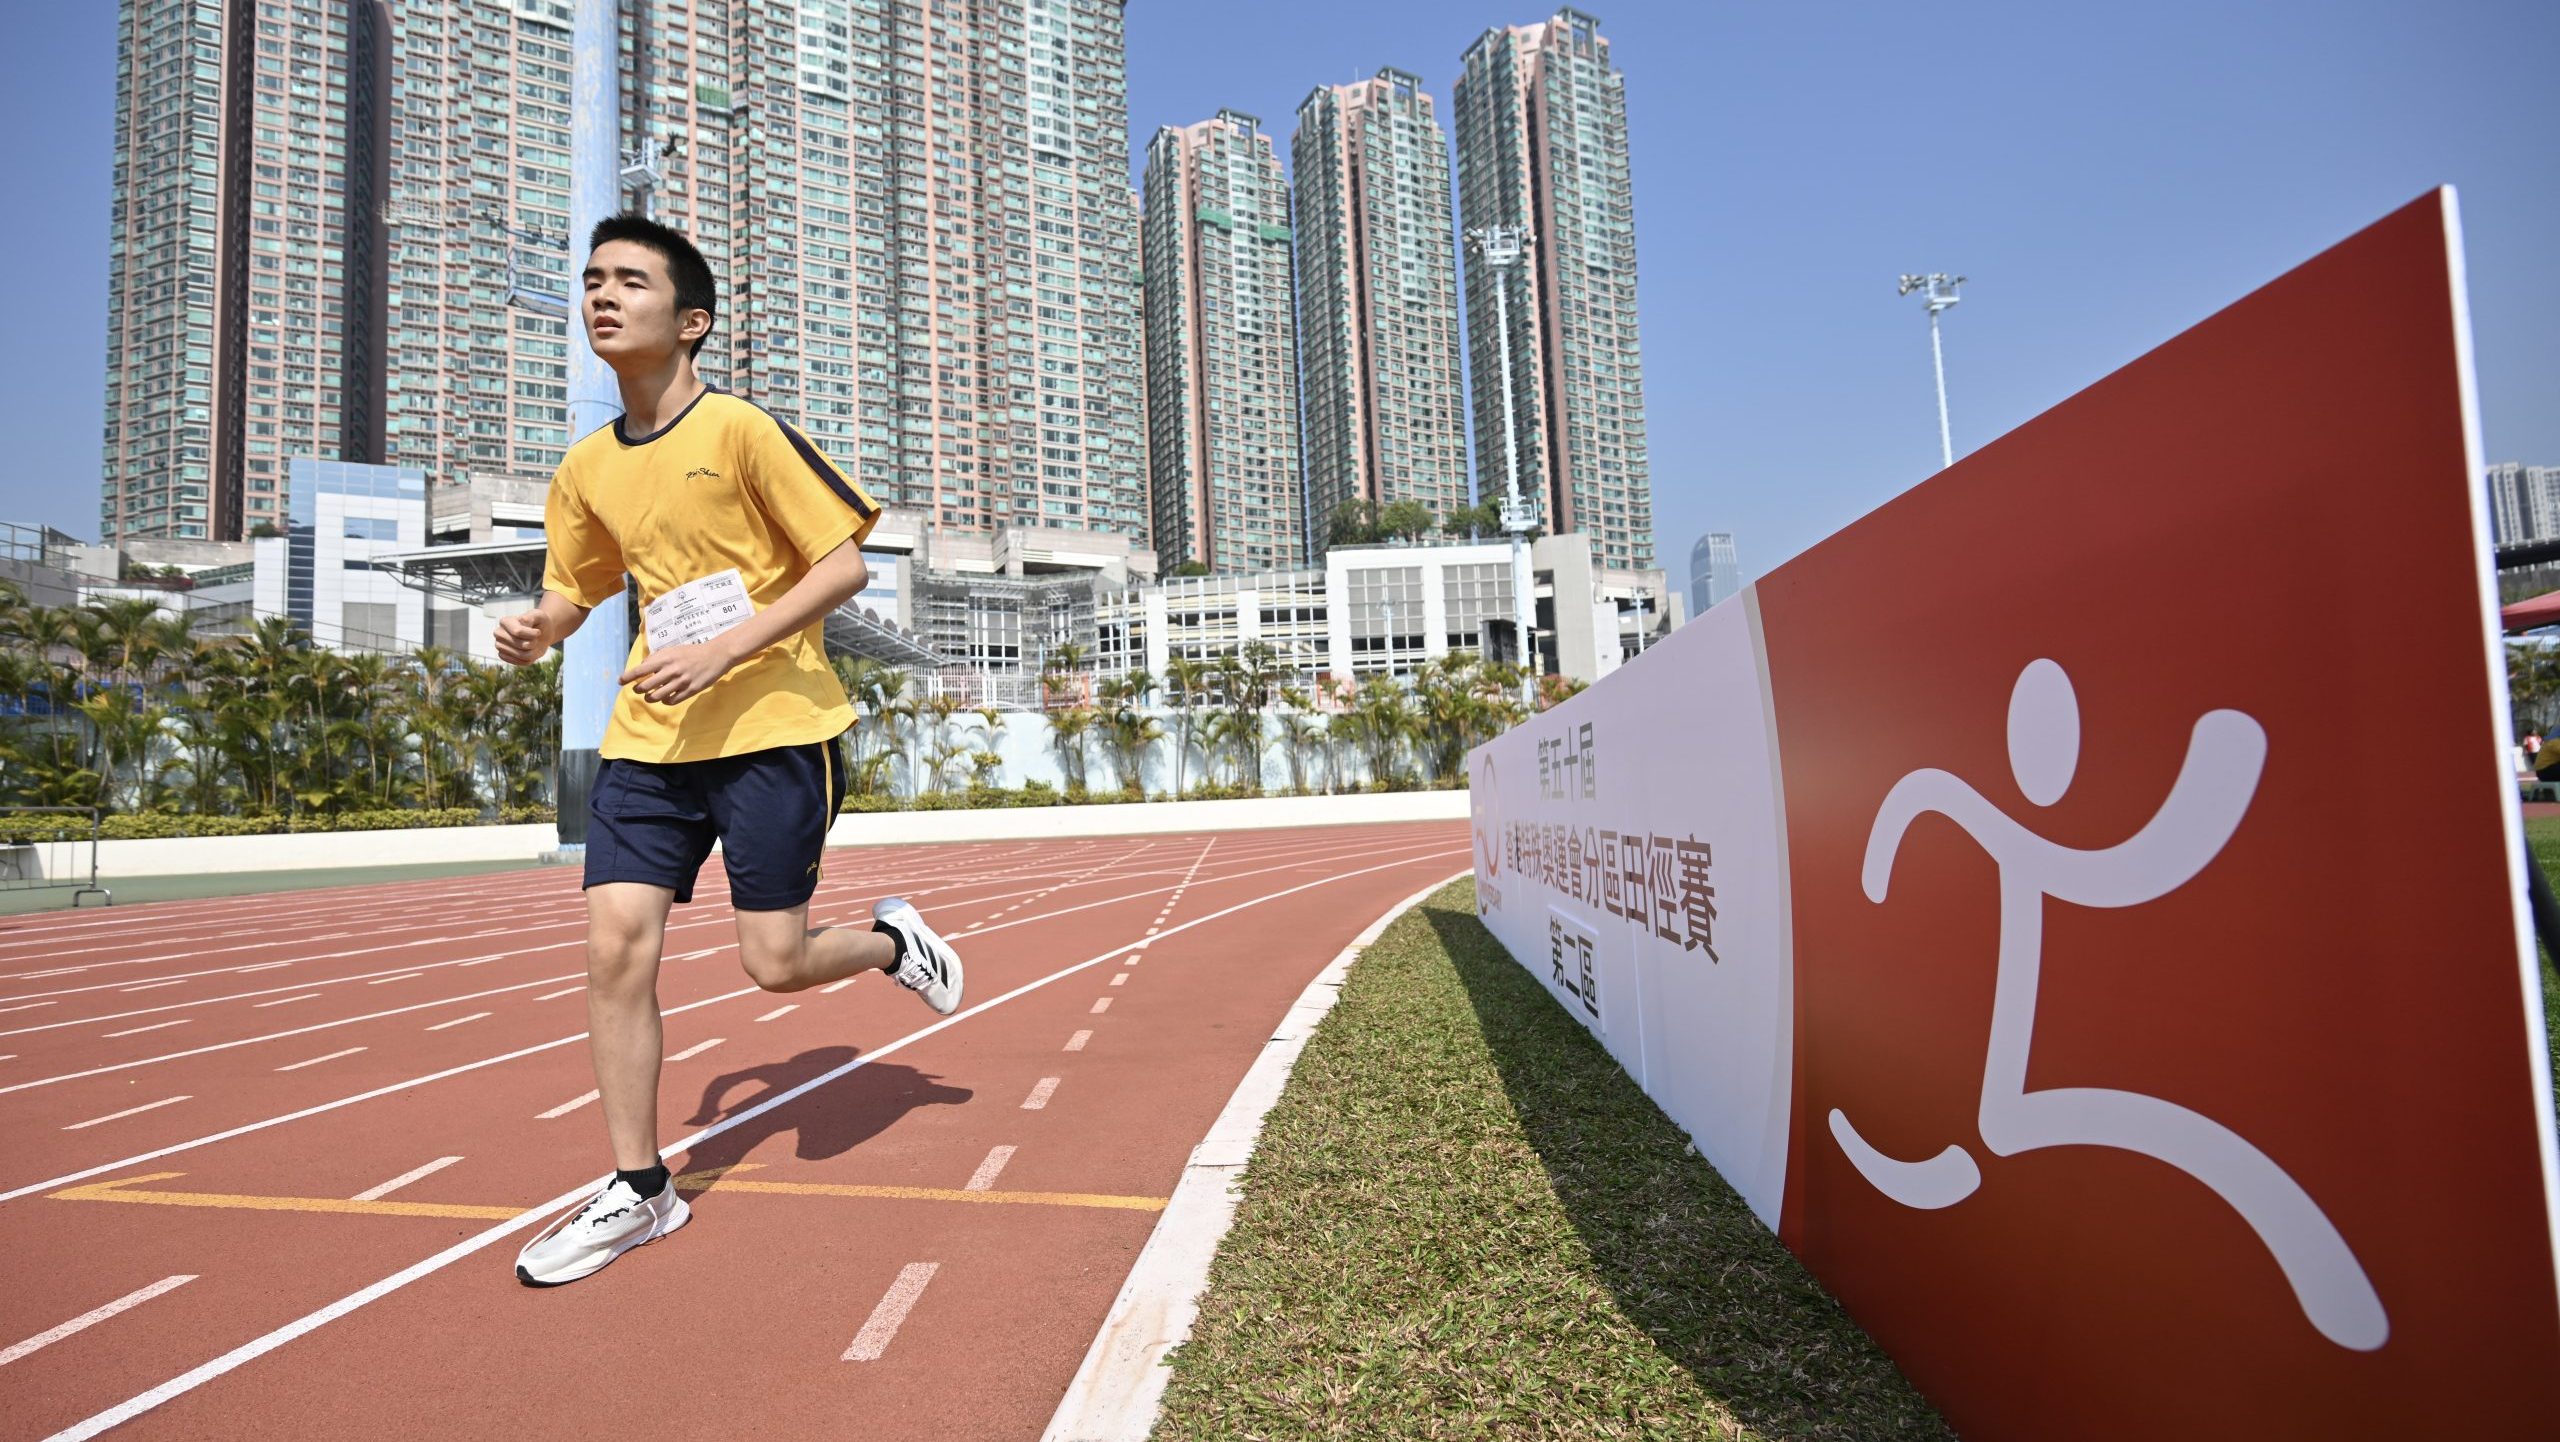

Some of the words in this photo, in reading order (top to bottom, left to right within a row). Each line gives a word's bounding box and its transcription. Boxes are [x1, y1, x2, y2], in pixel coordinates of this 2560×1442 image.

[722, 604, 737, 614] 801
[1537, 721, 1597, 802] 第五十屆
[1505, 819, 1719, 965] 香港特殊奧運會分區田徑賽
[1549, 915, 1599, 1019] 第二區
